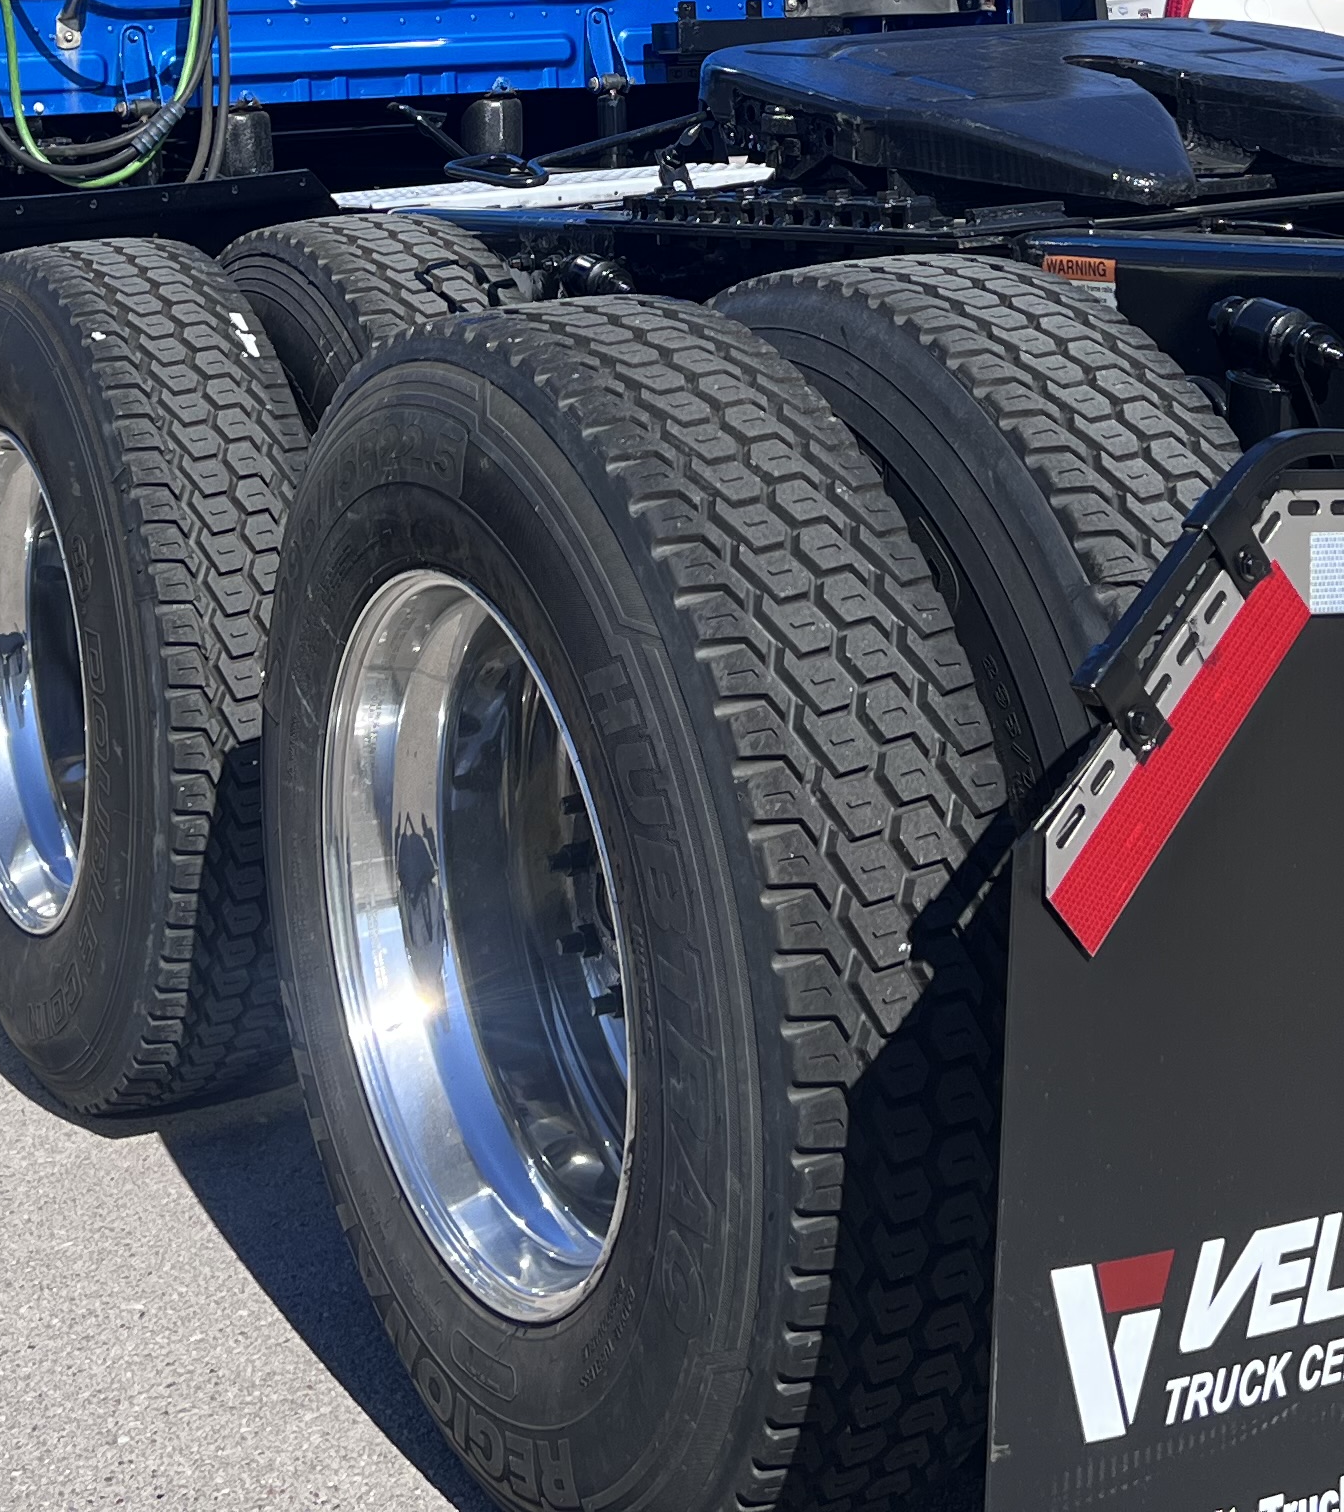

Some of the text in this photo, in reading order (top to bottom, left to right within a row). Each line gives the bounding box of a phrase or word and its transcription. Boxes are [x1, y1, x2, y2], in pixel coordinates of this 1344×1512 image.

[1046, 257, 1107, 278] WARNING
[77, 627, 113, 974] DOUBLE
[584, 659, 716, 1336] HUBTRAC
[1164, 1351, 1292, 1425] TRUCK
